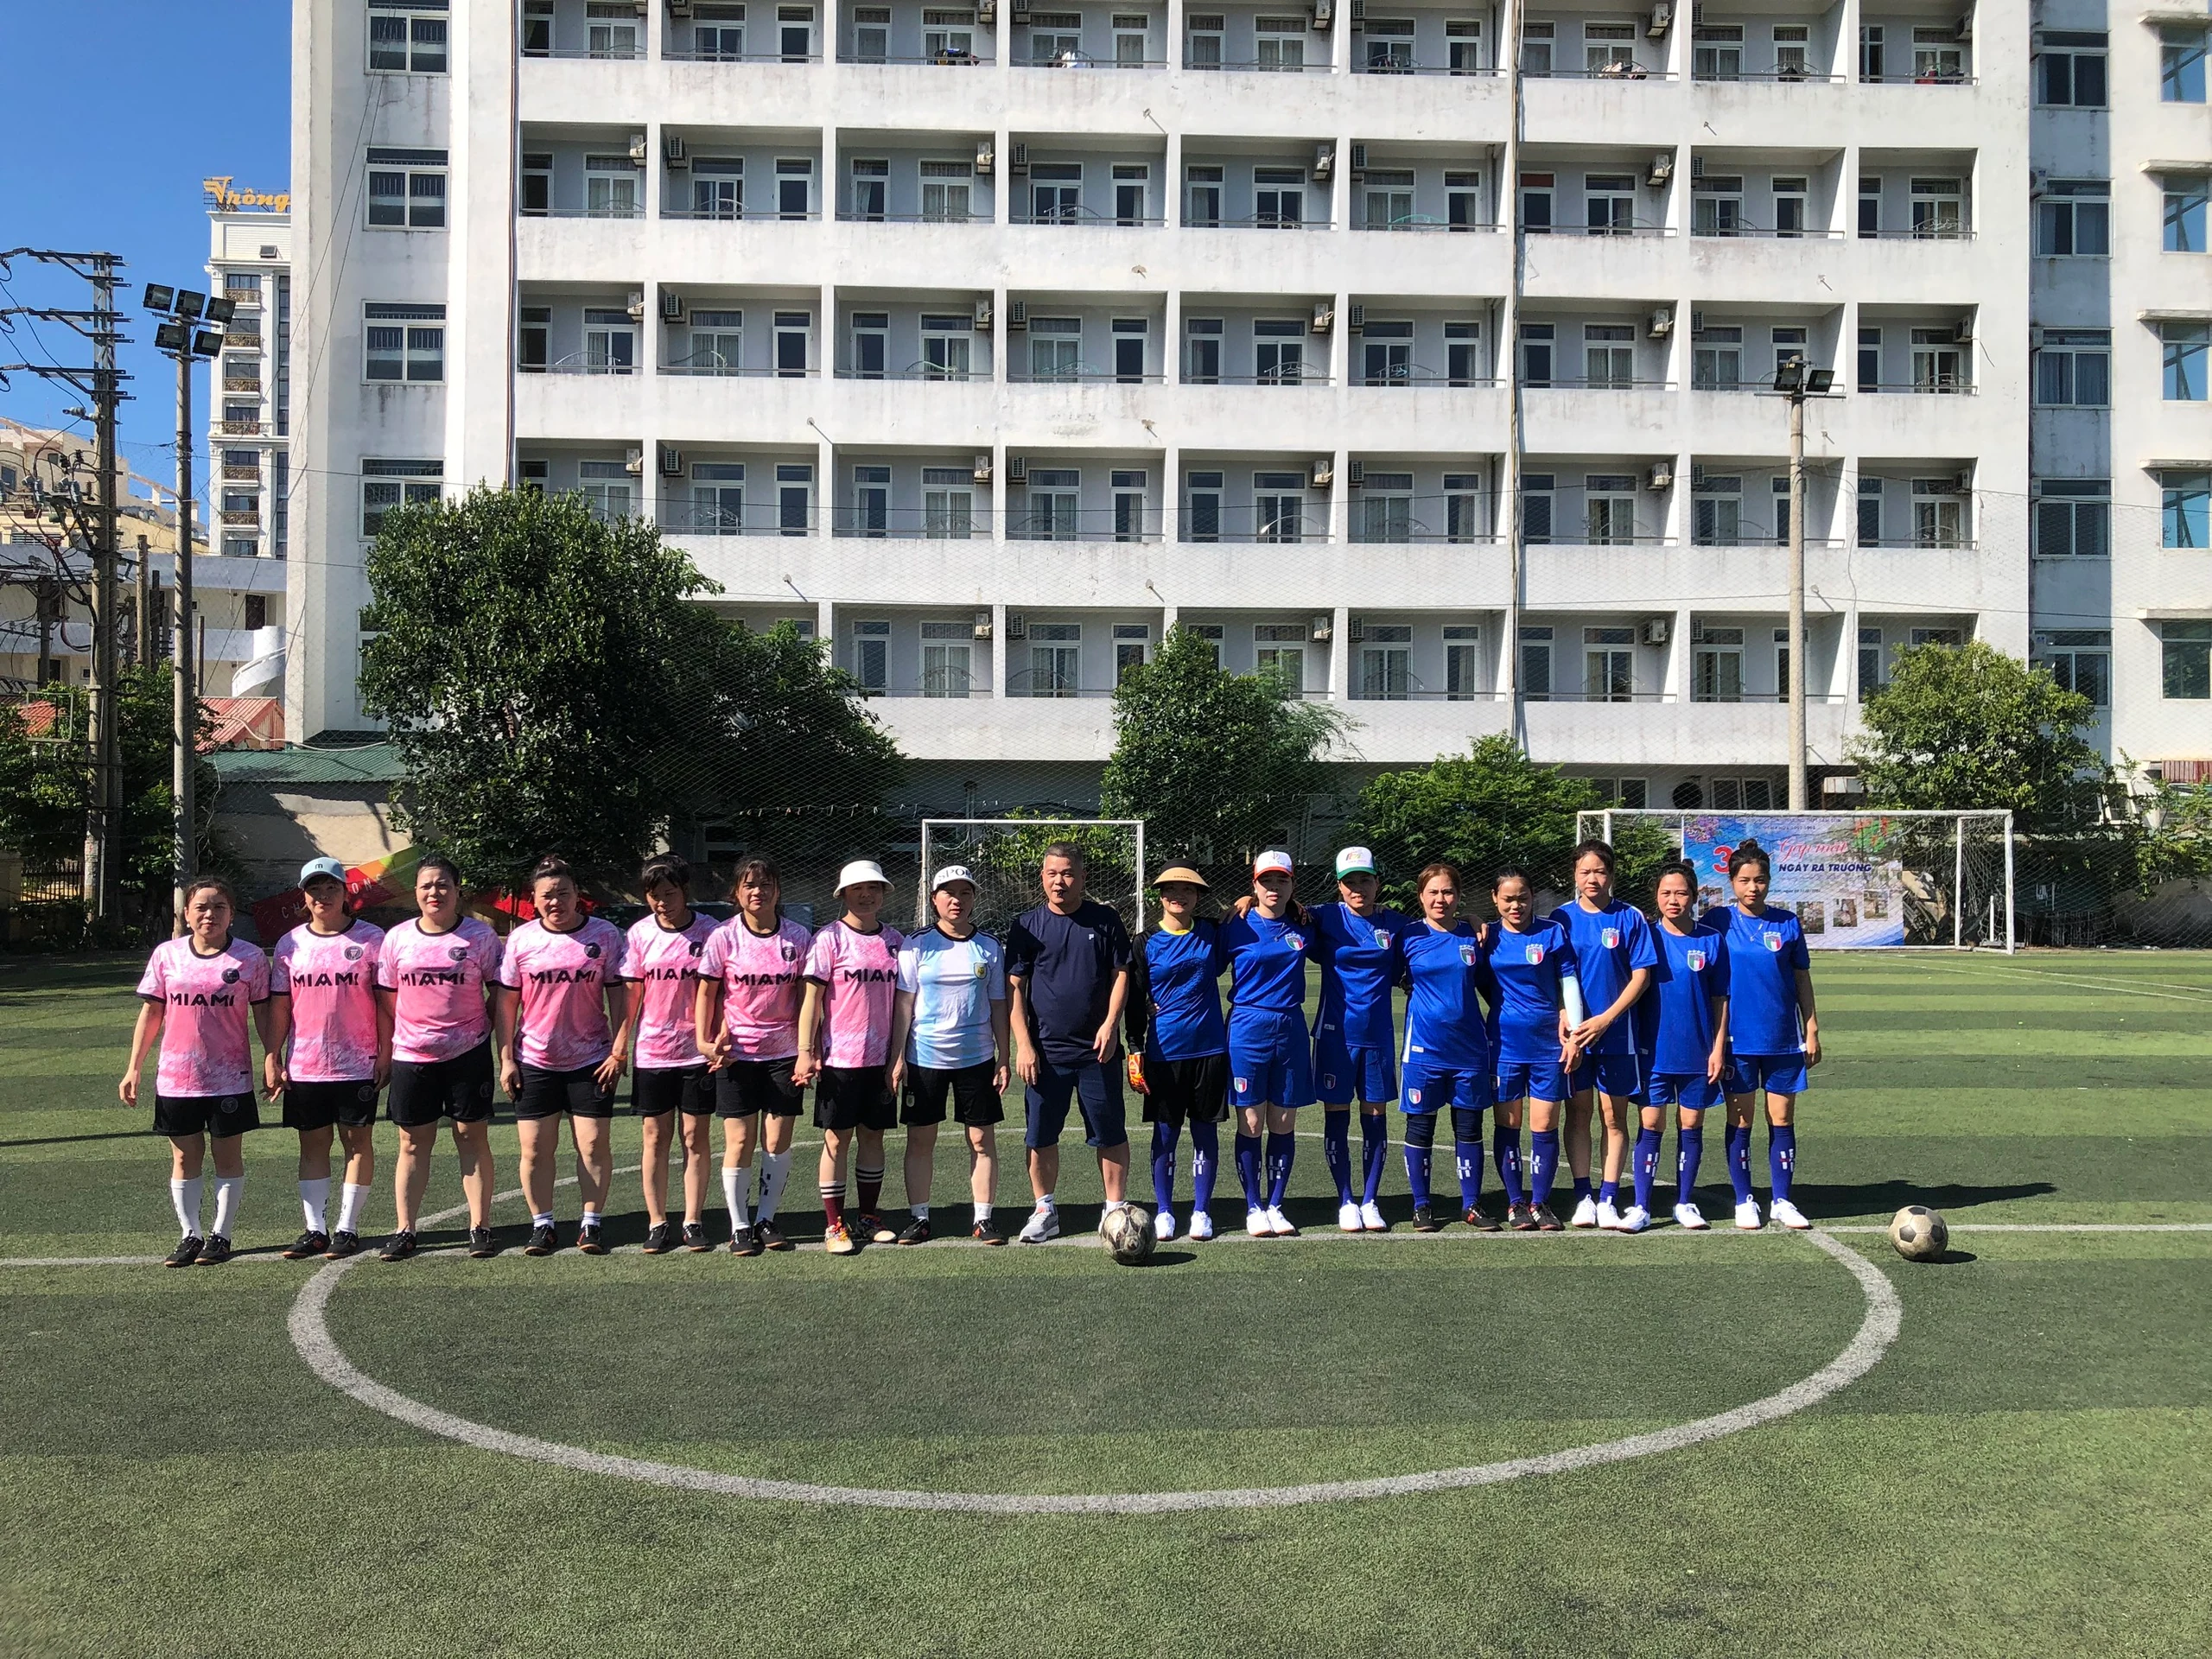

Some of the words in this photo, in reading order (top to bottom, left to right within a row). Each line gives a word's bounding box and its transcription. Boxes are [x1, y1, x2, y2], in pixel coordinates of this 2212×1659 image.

[1812, 863, 1825, 872] RA
[292, 972, 359, 988] MIAMI
[401, 972, 465, 987] MIAMI
[529, 969, 597, 984] MIAMI
[645, 968, 697, 981] MIAM
[843, 969, 899, 983] MIAM
[170, 993, 234, 1007] MIAMI
